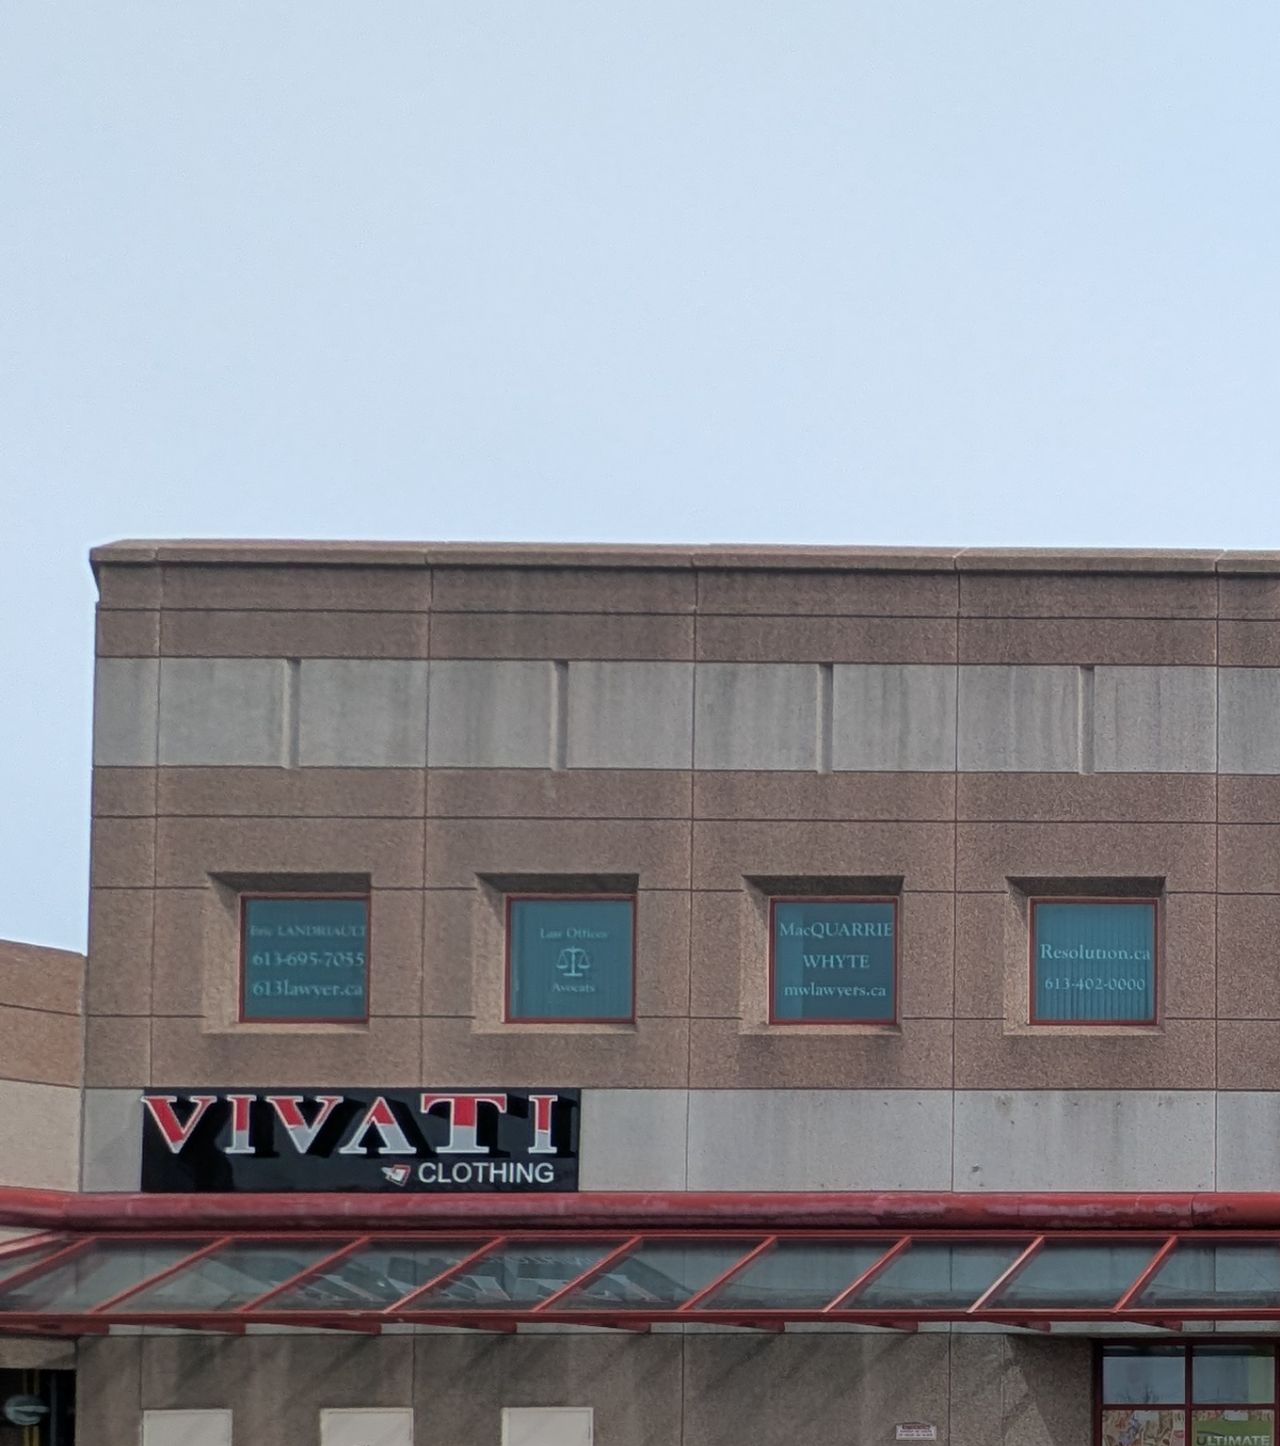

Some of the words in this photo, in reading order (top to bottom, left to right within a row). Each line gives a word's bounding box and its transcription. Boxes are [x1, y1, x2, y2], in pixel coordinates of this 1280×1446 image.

[540, 927, 562, 939] Law
[566, 927, 608, 939] Offices
[780, 922, 894, 938] MacQUARRIE
[252, 951, 366, 968] 613-695-7055
[1040, 943, 1151, 960] Resolution.ca
[803, 954, 871, 969] WHYTE
[252, 979, 363, 998] 613lawyer.ca
[552, 983, 596, 993] Avocats
[784, 982, 887, 998] mwlawyers.ca
[1045, 977, 1146, 991] 613-402-0000
[142, 1093, 558, 1155] VIVATI
[418, 1161, 556, 1184] CLOTHING
[1196, 1434, 1270, 1446] ULTIMATE
